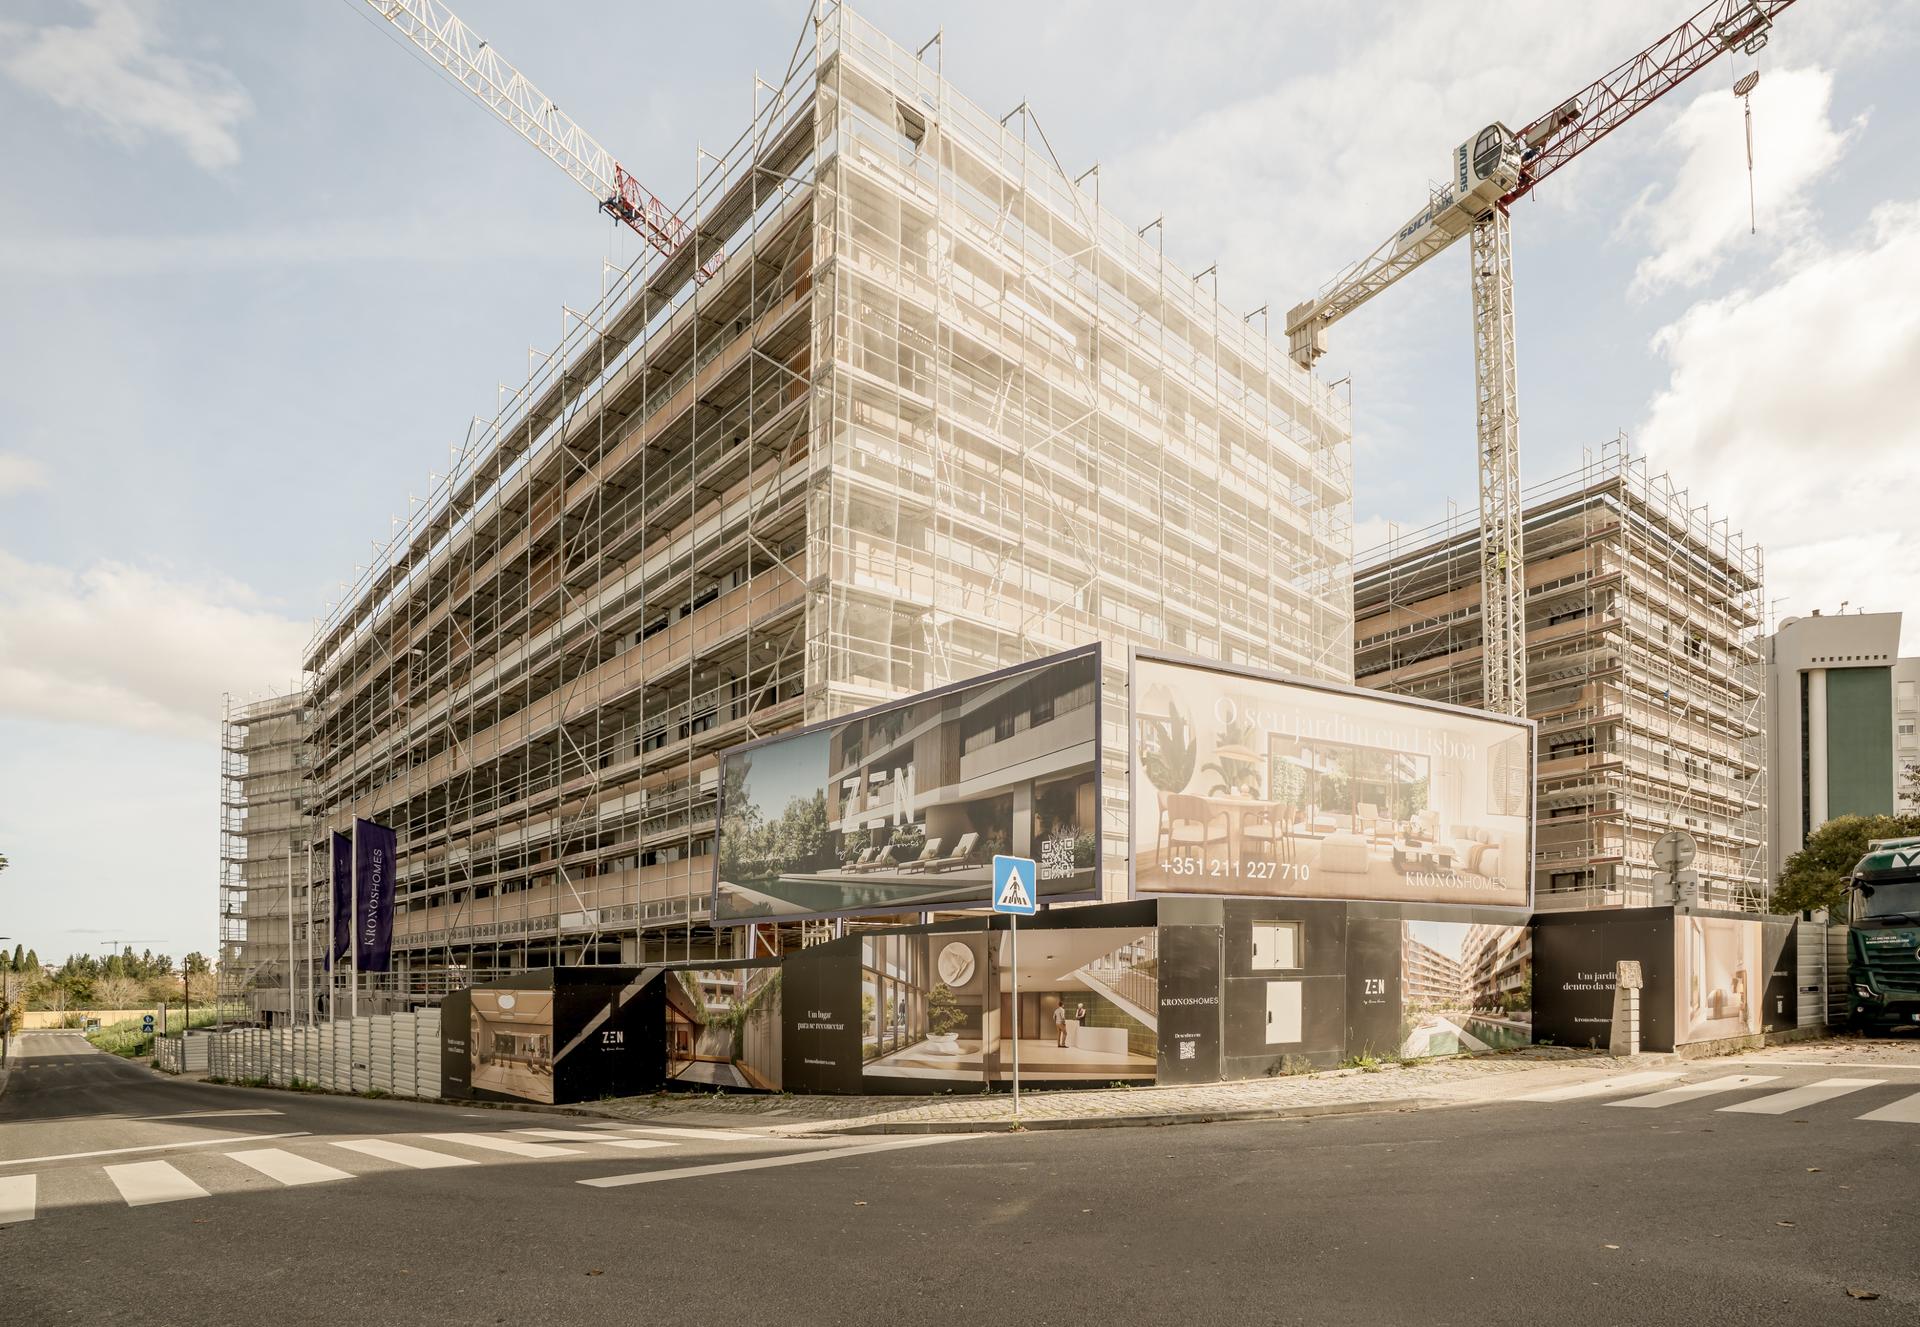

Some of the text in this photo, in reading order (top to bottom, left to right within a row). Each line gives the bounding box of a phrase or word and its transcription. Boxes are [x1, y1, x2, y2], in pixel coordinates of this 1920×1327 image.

[1214, 696, 1477, 761] O seu jardim em Lisboa
[841, 765, 916, 833] ZEN
[1161, 857, 1310, 880] +351 211 227 710
[1406, 871, 1507, 891] KRONOSHOMES
[364, 849, 382, 945] KRONOSHOMES
[1578, 972, 1617, 982] Um jardi
[1365, 979, 1385, 994] ZEN
[1562, 982, 1592, 991] dentro
[1593, 982, 1604, 991] da
[1161, 997, 1219, 1006] KRONOSHOMES
[602, 1031, 624, 1043] ZEN
